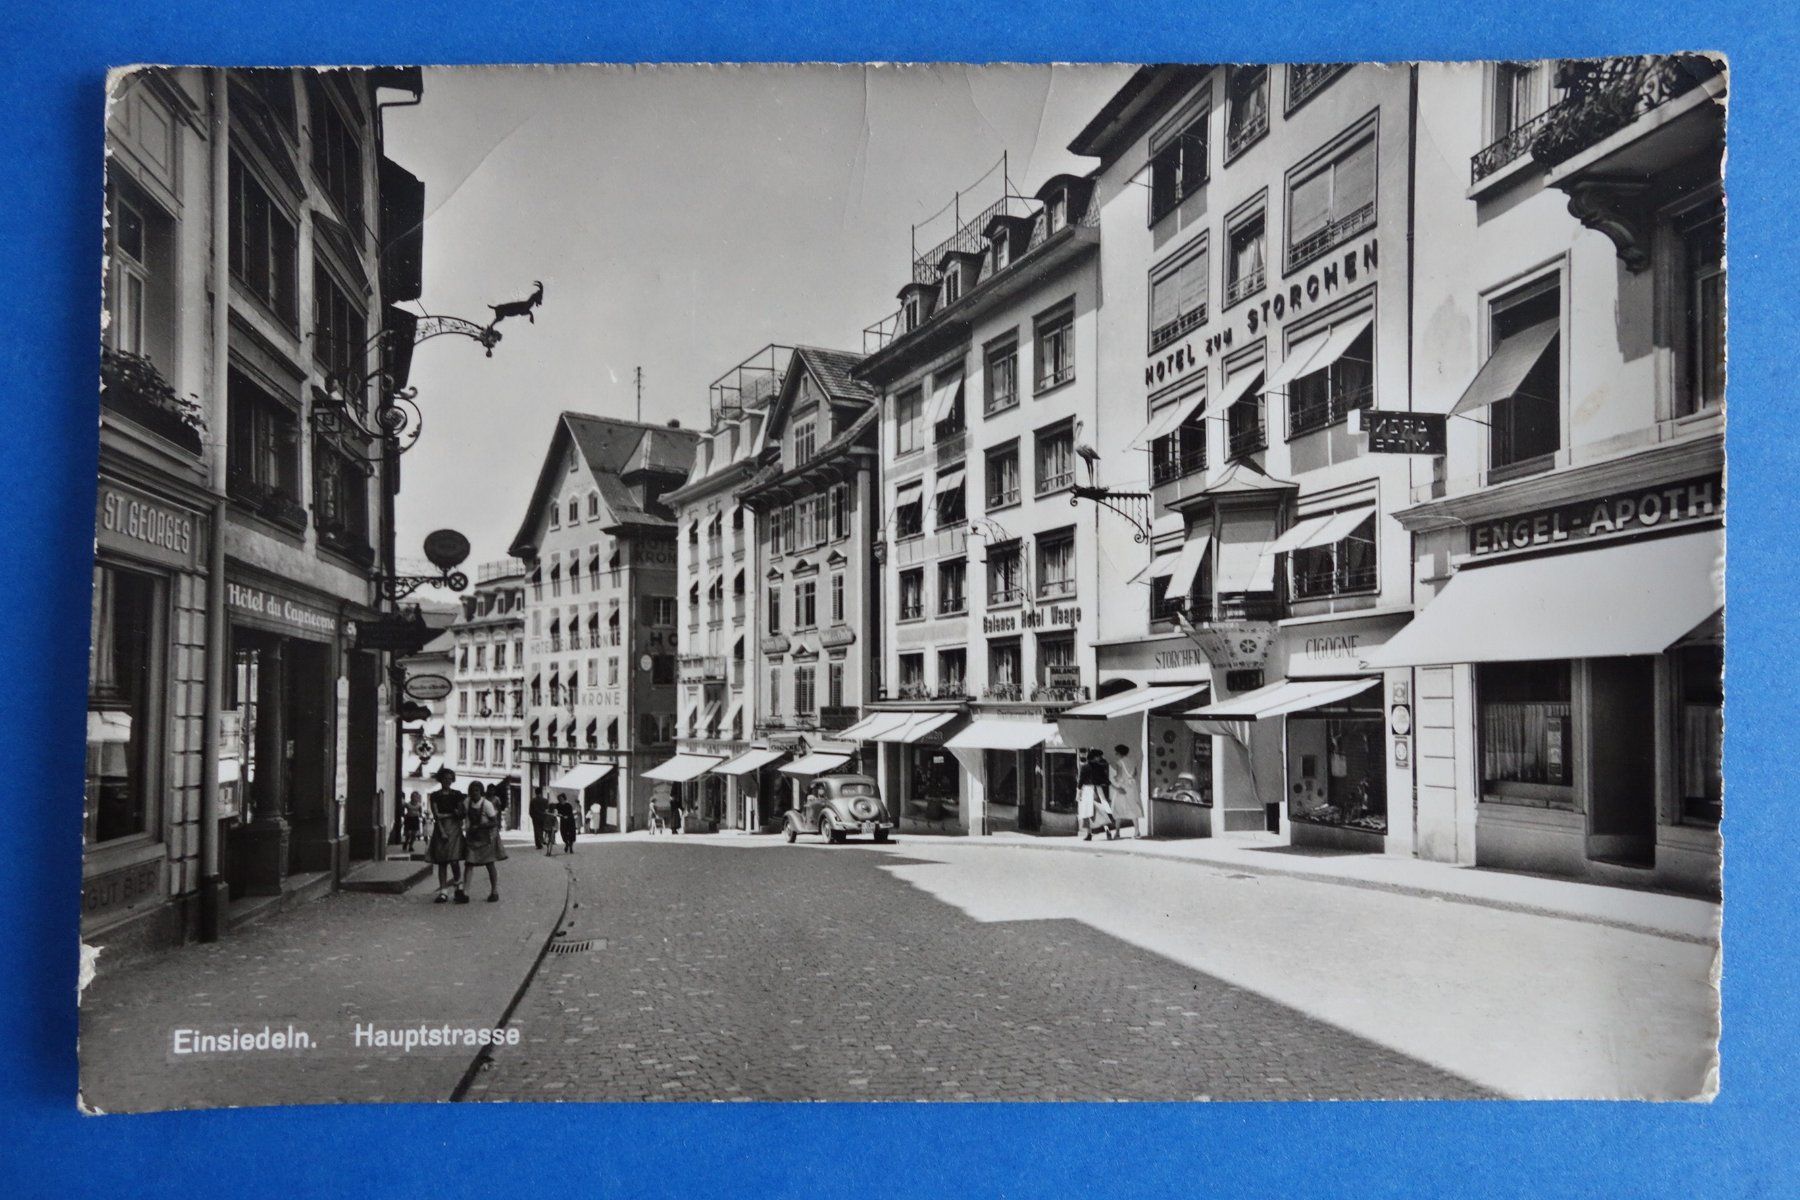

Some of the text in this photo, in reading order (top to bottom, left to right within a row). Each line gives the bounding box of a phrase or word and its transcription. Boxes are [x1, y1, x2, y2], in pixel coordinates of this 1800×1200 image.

[1145, 238, 1378, 386] HOTEL ZUM STORCHEN
[267, 595, 281, 616] du
[284, 602, 336, 632] Capricorne
[983, 605, 1082, 634] Balance Hotel Waage
[1154, 648, 1201, 670] STORCHEN
[1305, 635, 1360, 660] CIGOGNE
[581, 691, 621, 706] KRONE
